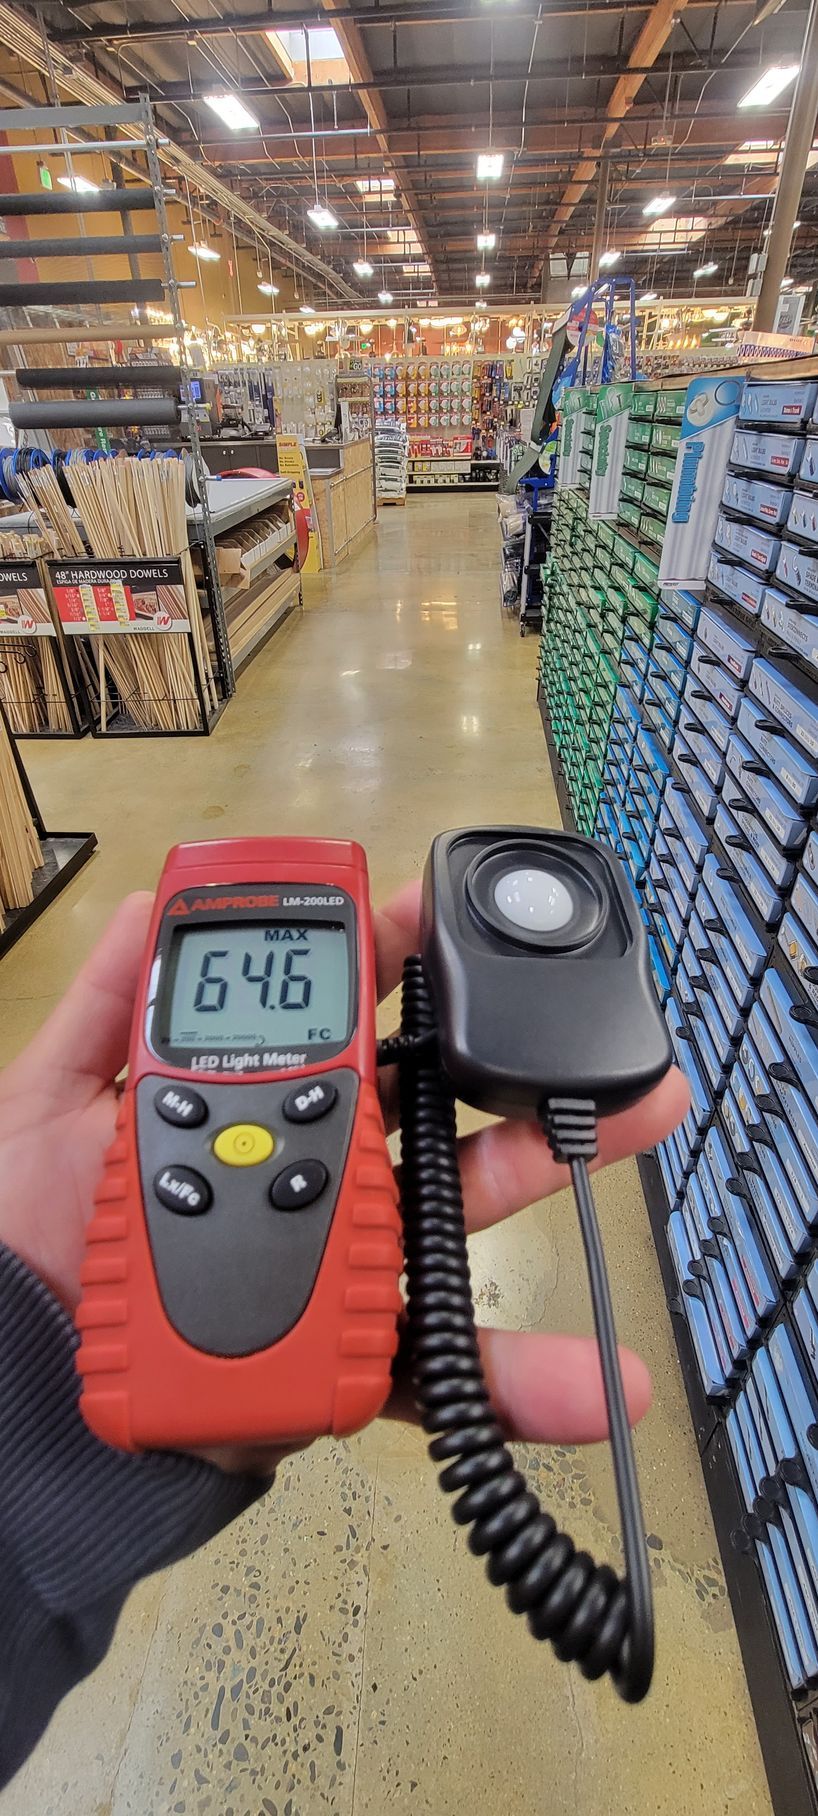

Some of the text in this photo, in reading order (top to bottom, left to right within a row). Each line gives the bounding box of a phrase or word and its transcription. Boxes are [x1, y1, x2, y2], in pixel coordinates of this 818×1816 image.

[671, 441, 705, 524] Plumbing
[55, 568, 169, 580] 48" HARDWOOD DOWELS
[190, 895, 345, 911] AMPROBE LM-200LED
[264, 929, 309, 942] MAX
[193, 949, 313, 1012] 64.6
[307, 1028, 332, 1041] FC
[190, 1052, 307, 1070] LED Light Meter
[162, 1091, 194, 1117] M-H
[293, 1085, 325, 1112] D-H
[159, 1171, 201, 1207] Lx/Fc
[290, 1174, 308, 1193] R
